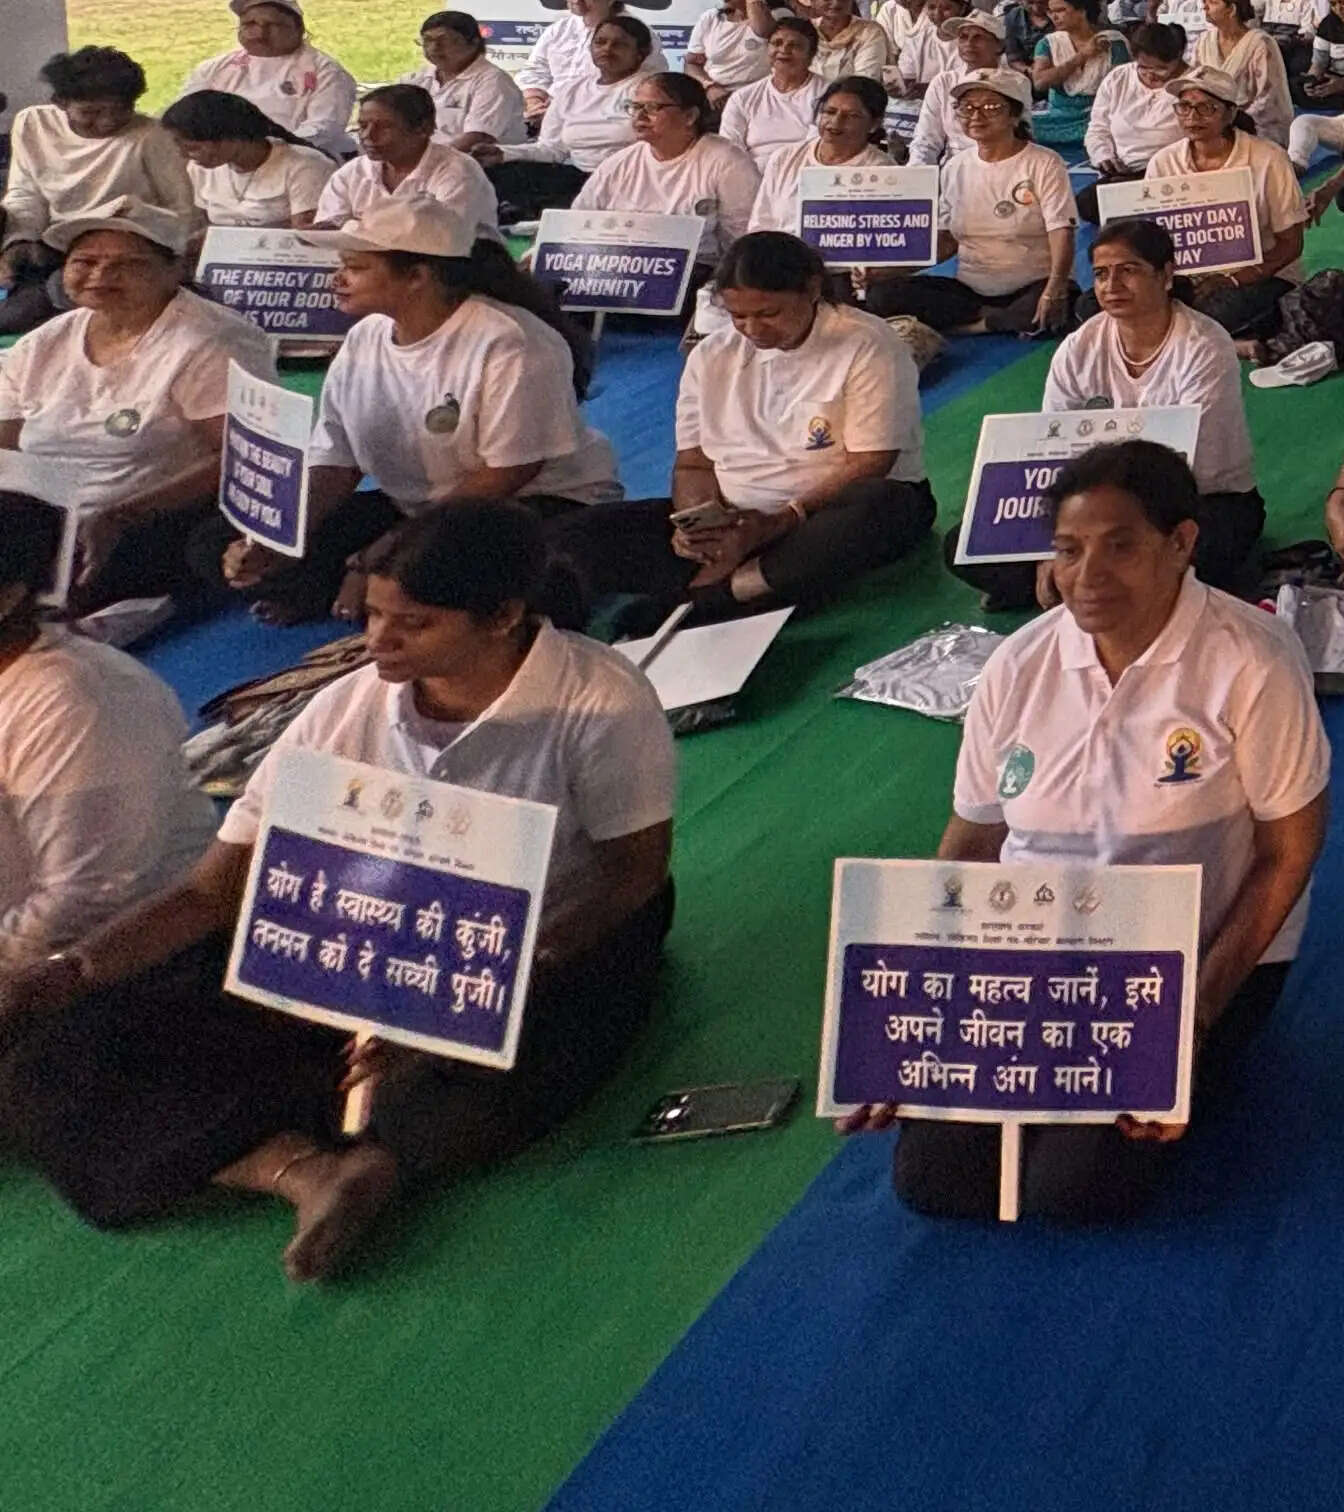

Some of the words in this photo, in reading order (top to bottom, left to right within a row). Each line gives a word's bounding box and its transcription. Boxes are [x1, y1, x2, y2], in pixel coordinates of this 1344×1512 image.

[803, 214, 857, 229] RELEASING
[858, 214, 901, 228] STRESS
[903, 214, 930, 228] AND
[1207, 207, 1242, 225] DAY,
[819, 233, 854, 248] ANGER
[856, 233, 873, 248] BY
[874, 233, 906, 247] YOGA
[1186, 224, 1245, 246] DOCTOR
[545, 253, 584, 272] YOGA
[586, 254, 677, 276] IMPROVES
[211, 269, 242, 285] THE
[242, 269, 309, 287] ENERGY
[223, 289, 245, 305] OF
[246, 291, 292, 307] YOUR
[262, 311, 309, 328] YOGA
[267, 861, 303, 903] योग
[310, 870, 328, 913] है
[335, 888, 406, 931] स्वास्थ्य
[416, 900, 446, 941] की
[455, 912, 512, 963] कुंजी,
[253, 918, 312, 963] तनमन
[319, 933, 348, 972] को
[357, 940, 377, 981] दे
[385, 954, 442, 997] सच्ची
[861, 959, 908, 998] योग
[923, 972, 955, 1001] का
[969, 974, 1033, 1004] महत्व
[1048, 966, 1108, 1009] जानें,
[1125, 966, 1164, 1010] इसे
[885, 1006, 944, 1045] अपने
[959, 1008, 1026, 1048] जीवन
[1042, 1020, 1075, 1048] का
[1090, 1021, 1134, 1055] एक
[898, 1050, 978, 1094] अभिन्न
[993, 1055, 1039, 1094] अंग
[1053, 1055, 1113, 1096] माने।
